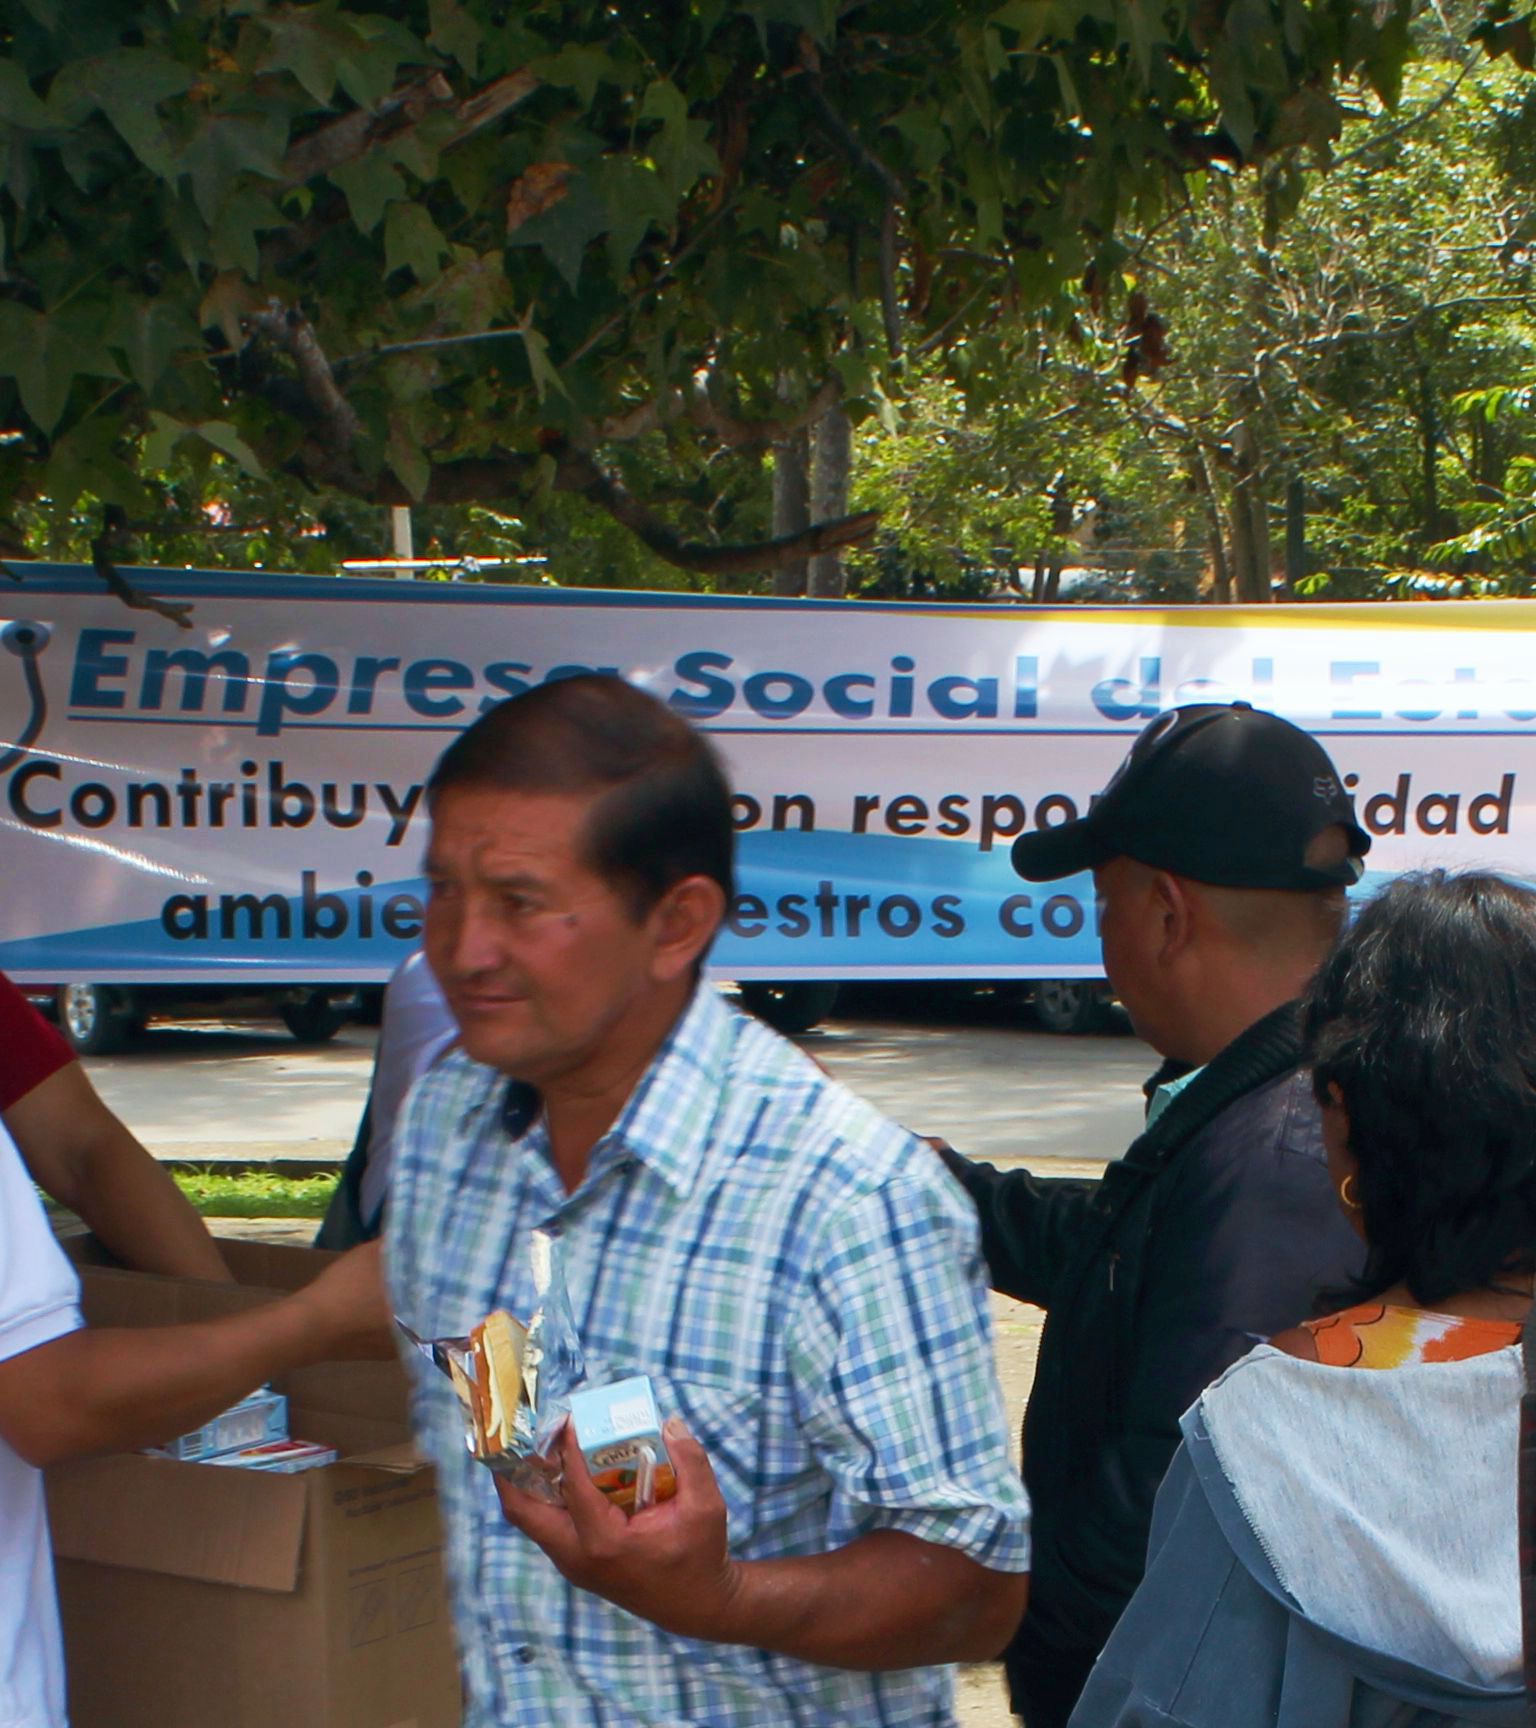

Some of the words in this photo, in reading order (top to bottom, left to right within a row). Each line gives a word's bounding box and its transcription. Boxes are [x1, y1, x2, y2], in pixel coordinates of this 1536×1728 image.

[68, 628, 619, 736] Empres
[667, 651, 1038, 719] Social
[7, 759, 427, 846] Contribuy
[731, 793, 816, 832] on
[161, 870, 426, 940] ambie
[727, 880, 965, 938] estros
